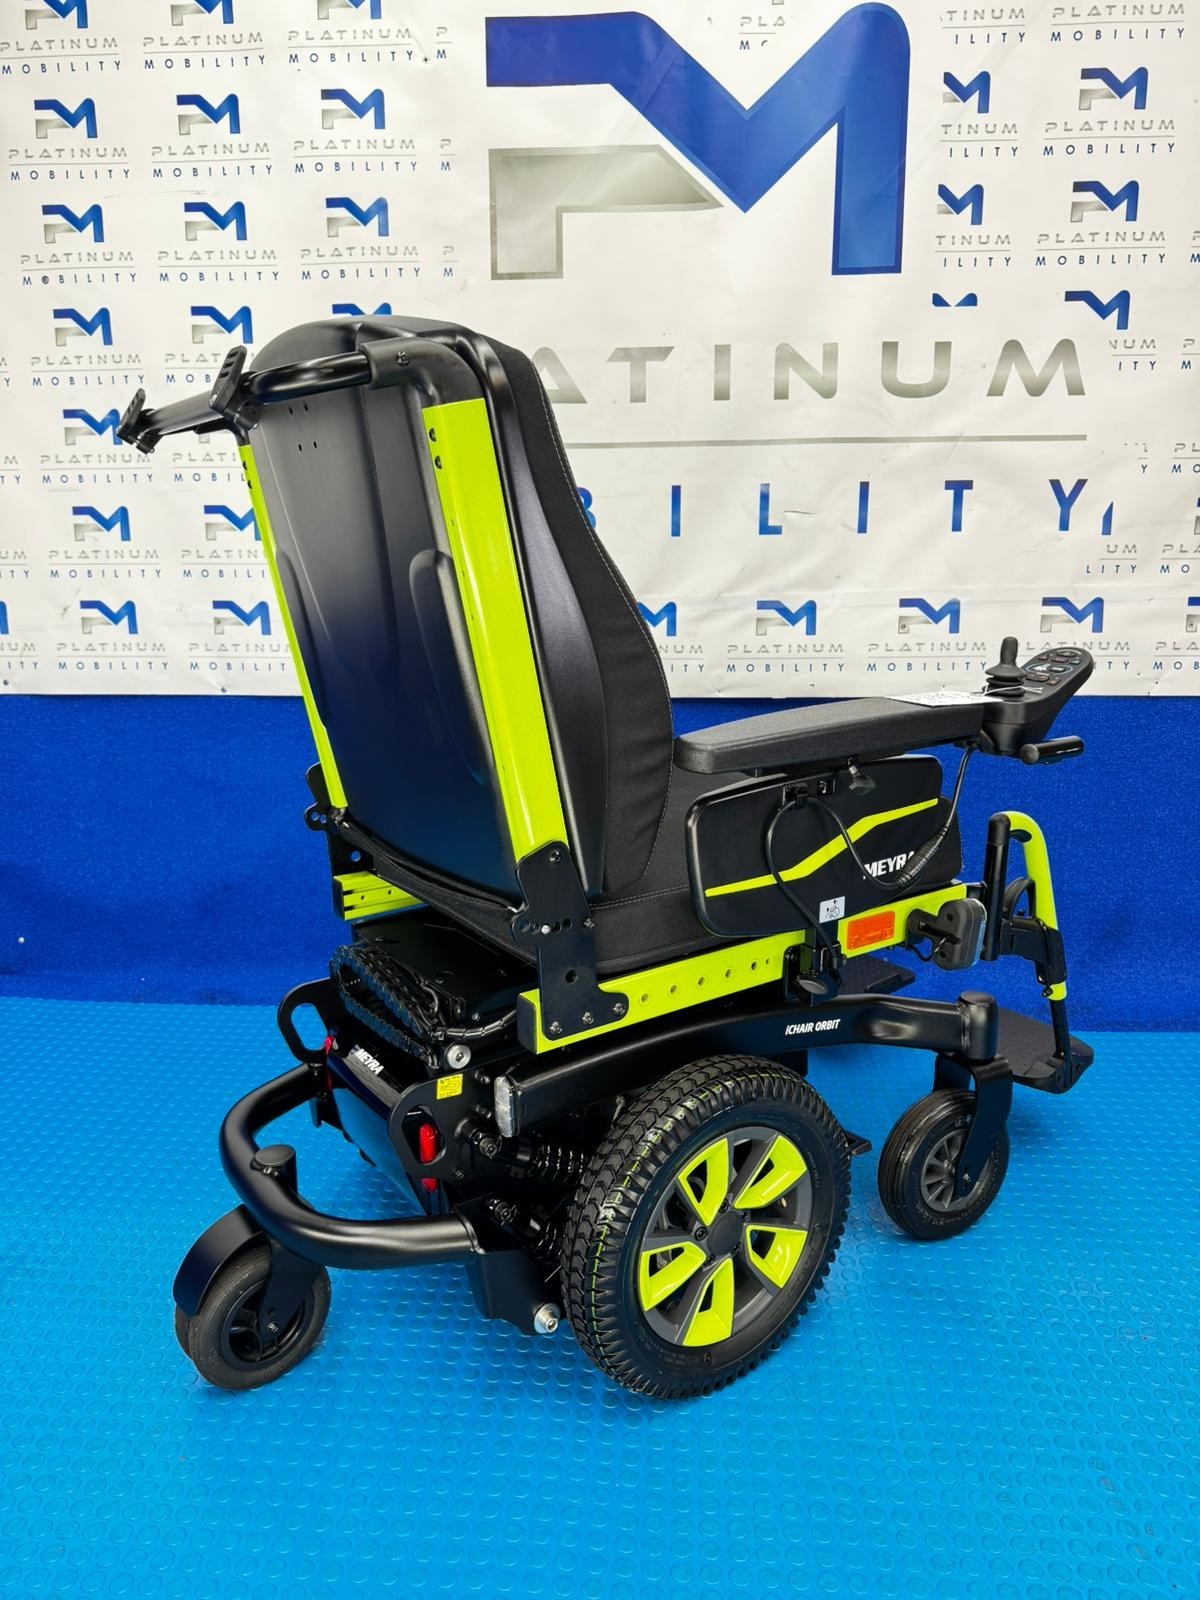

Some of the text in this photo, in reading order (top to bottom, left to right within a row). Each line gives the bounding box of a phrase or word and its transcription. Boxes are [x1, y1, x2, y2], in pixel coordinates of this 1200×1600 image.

[1052, 3, 1184, 18] PLATINUM
[143, 32, 263, 47] PLATINUM
[288, 28, 412, 41] PLATINUM
[1050, 28, 1185, 42] MOBILITY
[1, 38, 118, 51] PLATINUM
[144, 55, 266, 68] MOBILITY
[289, 50, 413, 63] MOBILITY
[1, 61, 121, 74] MOBILITY
[1045, 119, 1175, 133] PLATINUM
[152, 142, 270, 156] PLATINUM
[294, 138, 415, 151] PLATINUM
[1043, 143, 1175, 156] MOBILITY
[9, 147, 127, 159] PLATINUM
[152, 164, 273, 178] MOBILITY
[295, 161, 417, 174] MOBILITY
[10, 169, 130, 181] MOBILITY
[1037, 231, 1166, 244] PLATINUM
[20, 251, 134, 264] PLATINUM
[158, 249, 277, 260] PLATINUM
[301, 246, 419, 259] PLATINUM
[1035, 254, 1166, 265] MOBILITY
[23, 273, 136, 286] MOBILITY
[160, 271, 279, 283] MOBILITY
[302, 267, 420, 280] MOBILITY
[30, 354, 141, 366] PLATINUM
[33, 375, 145, 387] MOBILITY
[41, 453, 151, 464] PLATINUM
[43, 475, 153, 485] MOBILITY
[49, 550, 159, 560] PLATINUM
[182, 550, 265, 560] PLATIN
[50, 569, 161, 579] MOBILITY
[57, 643, 166, 652] PLATINUM
[728, 643, 843, 653] PLATINUM
[868, 641, 986, 652] PLATINUM
[59, 661, 168, 671] MOBILITY
[727, 663, 844, 673] MOBILITY
[867, 661, 986, 672] MOBILITY
[815, 1018, 841, 1032] ORBIT
[356, 1048, 384, 1075] MEYRA
